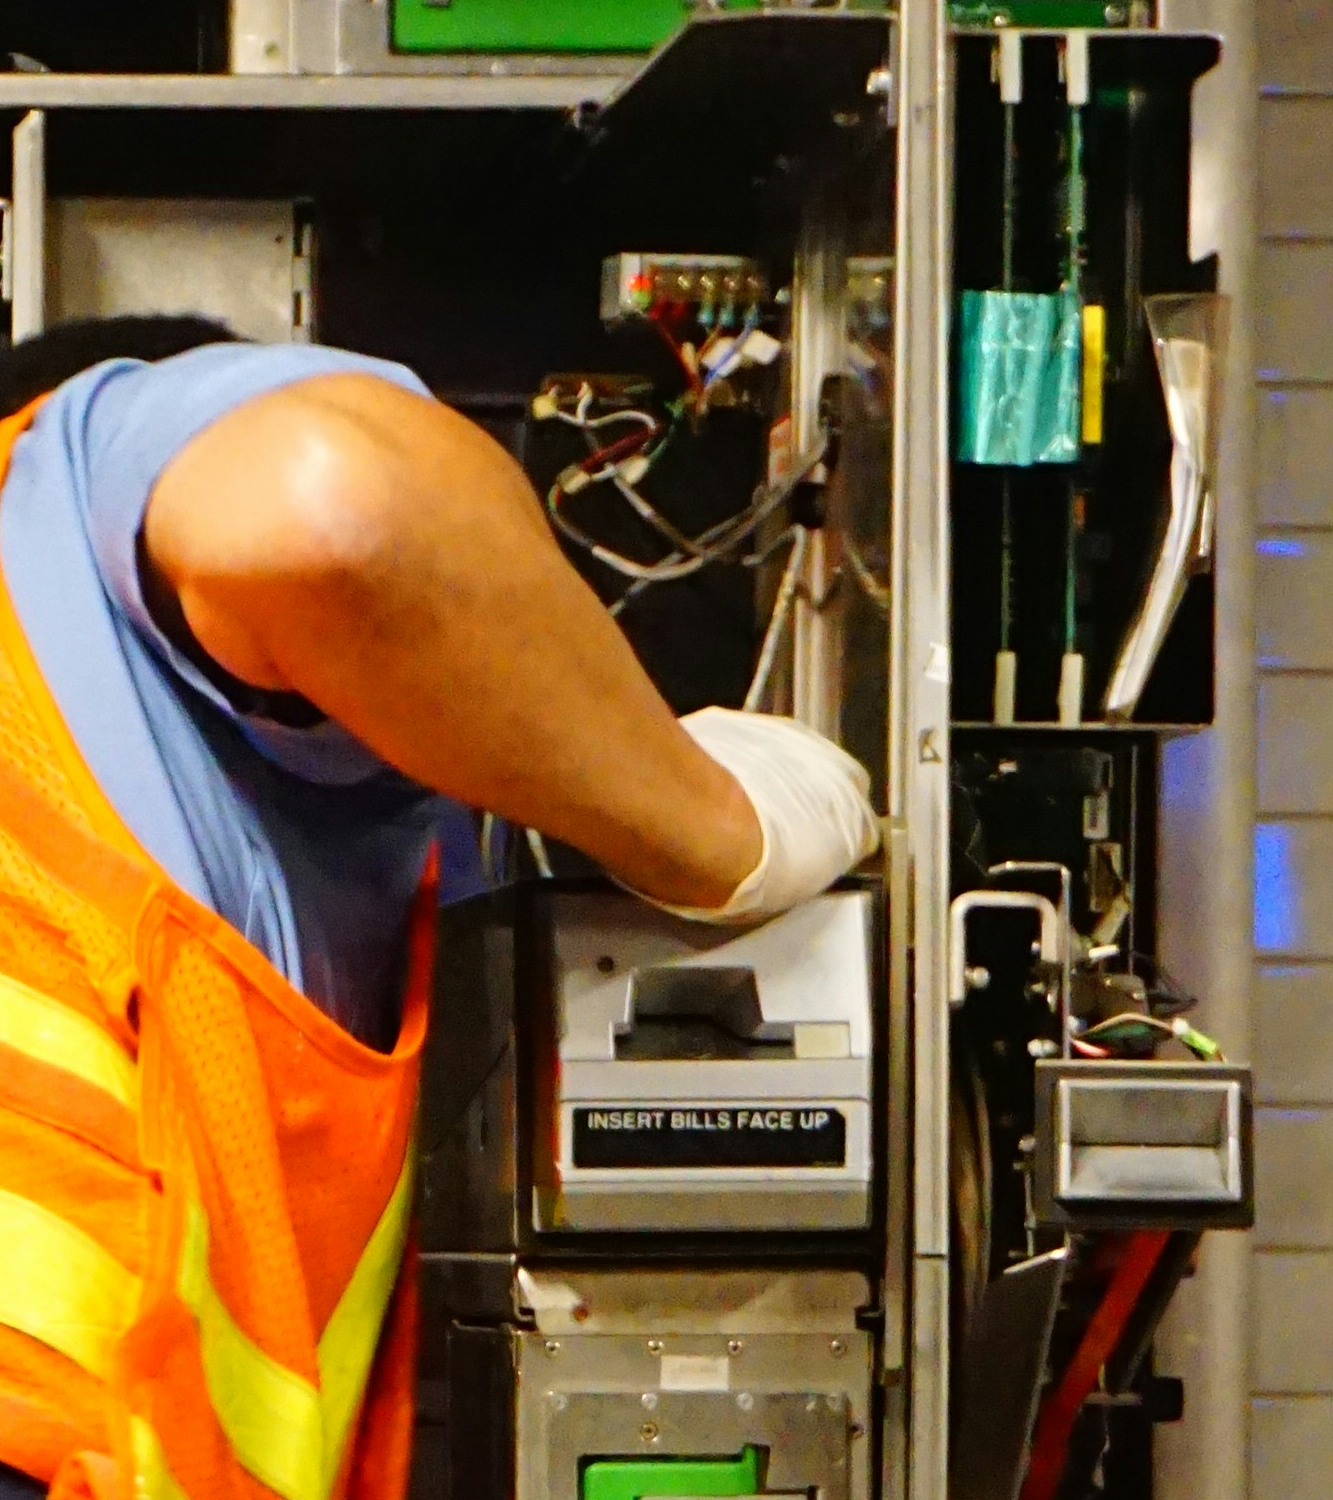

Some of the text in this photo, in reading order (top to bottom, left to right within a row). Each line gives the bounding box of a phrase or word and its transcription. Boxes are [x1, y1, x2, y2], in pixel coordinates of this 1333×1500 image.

[587, 1111, 830, 1130] INSERT BILLS FACE UP
